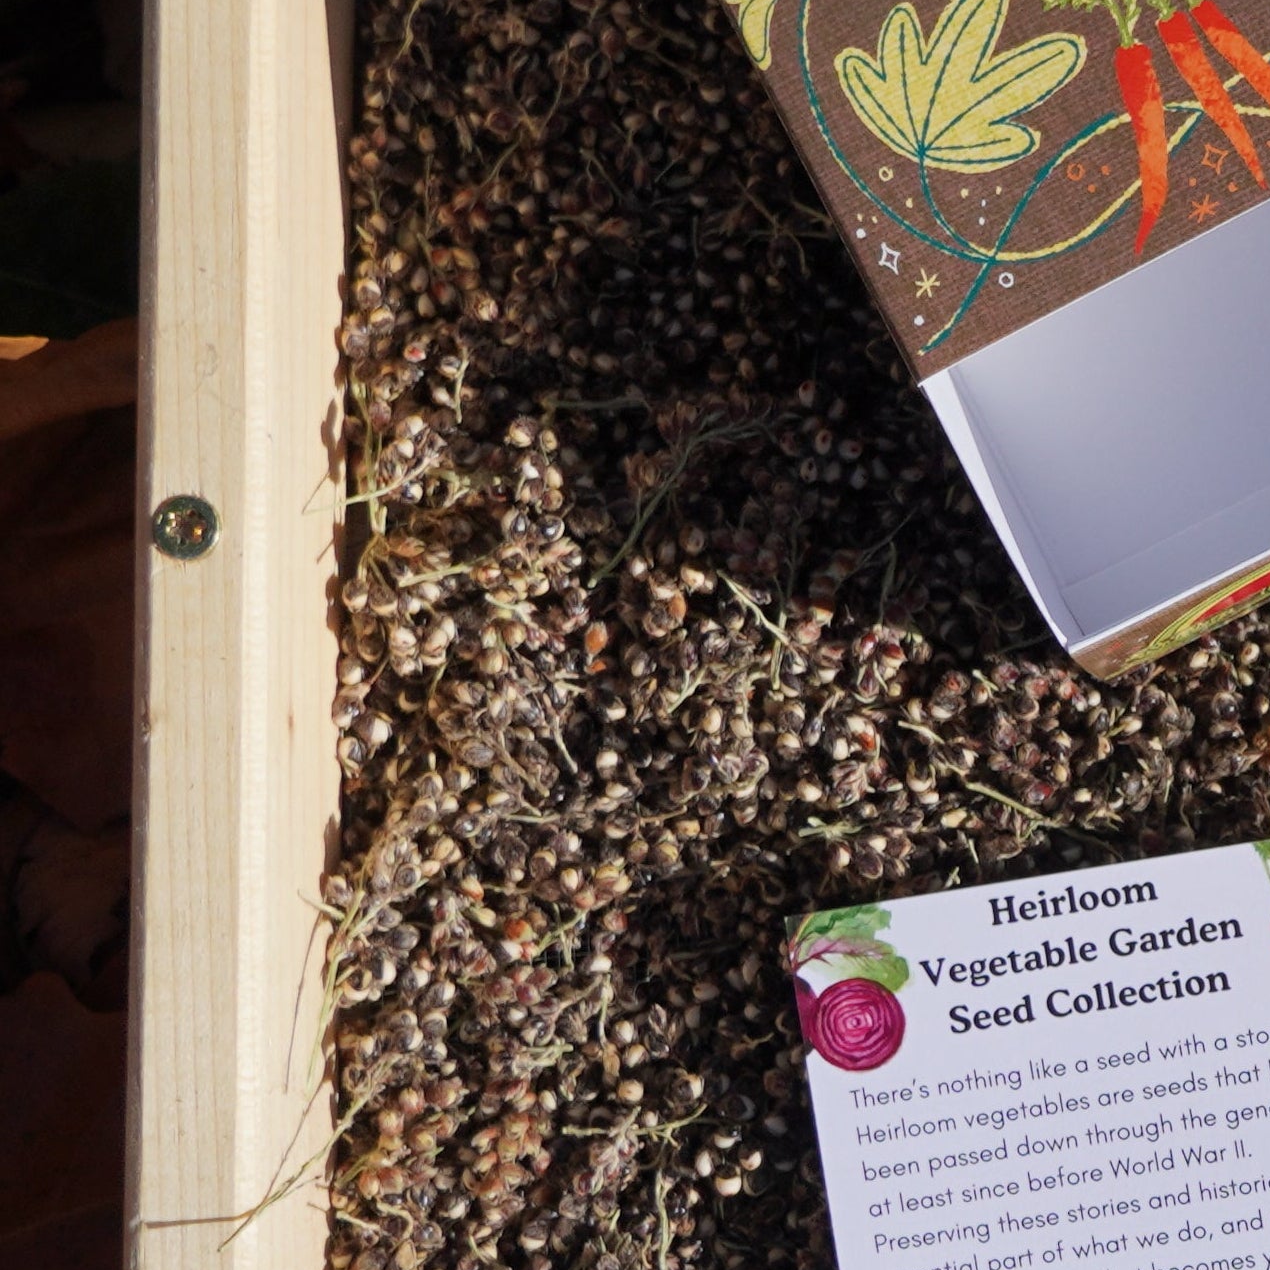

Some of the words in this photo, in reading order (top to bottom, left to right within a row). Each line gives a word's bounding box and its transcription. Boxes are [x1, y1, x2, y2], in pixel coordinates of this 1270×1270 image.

[988, 881, 1159, 926] Heirloom
[918, 936, 1098, 988] Vegetable
[1108, 917, 1244, 957] Garden
[948, 994, 1036, 1034] Seed
[1046, 970, 1232, 1018] Collection
[848, 1078, 930, 1109] There's
[937, 1068, 1022, 1096] nothing
[1028, 1057, 1067, 1081] like
[1074, 1059, 1089, 1074] a
[1096, 1041, 1151, 1071] seed
[1158, 1033, 1206, 1061] with
[1213, 1037, 1228, 1052] a
[856, 1117, 957, 1146] Heirloom
[963, 1091, 1091, 1131] vegetables
[1097, 1089, 1135, 1107] are
[1142, 1070, 1209, 1100] seeds
[1214, 1064, 1261, 1088] that
[861, 1160, 920, 1182] been
[928, 1137, 1009, 1178] passed
[1016, 1134, 1079, 1157] down
[1085, 1113, 1173, 1146] through
[1180, 1108, 1217, 1131] the
